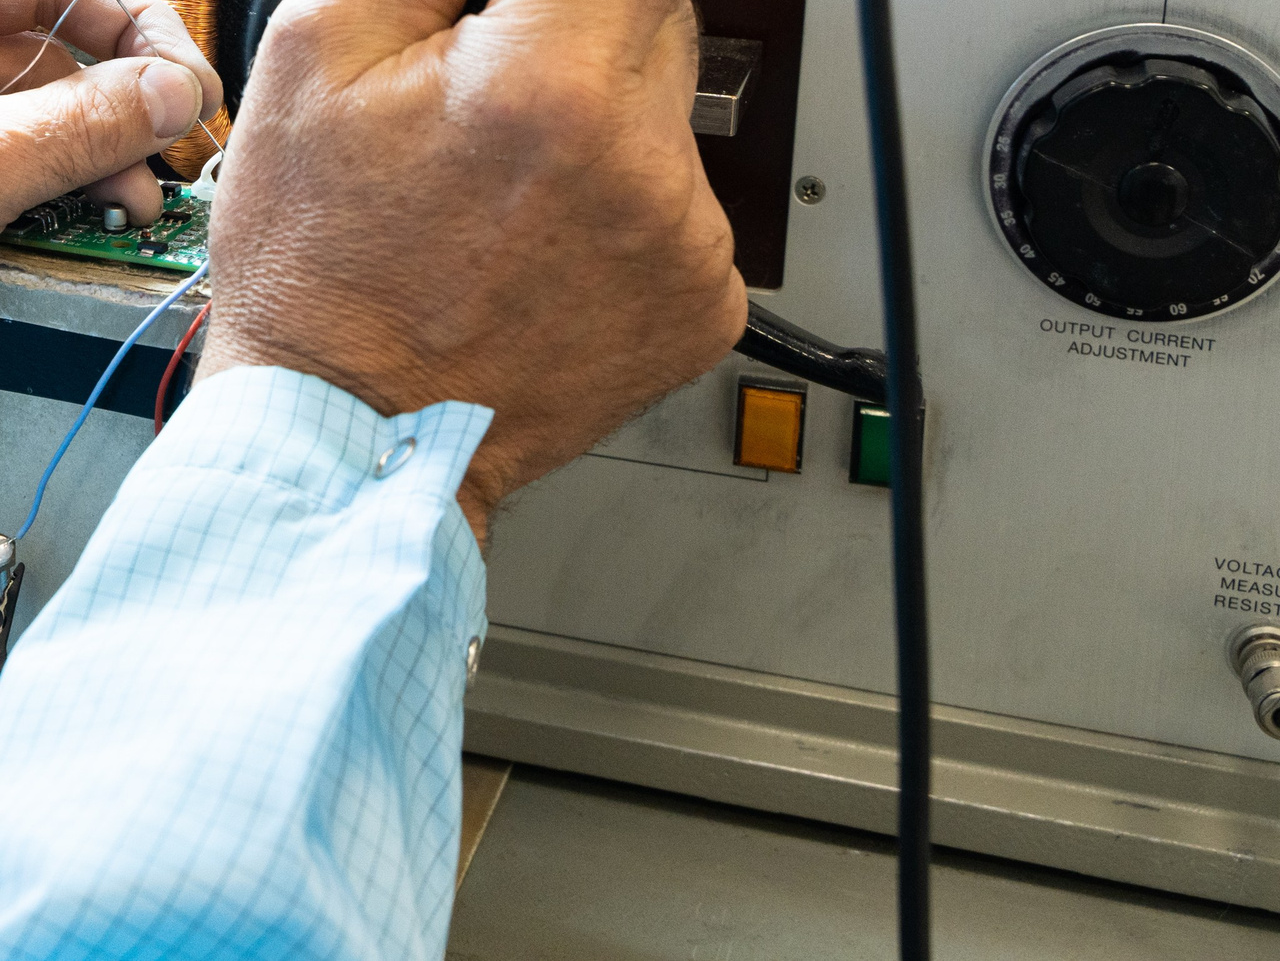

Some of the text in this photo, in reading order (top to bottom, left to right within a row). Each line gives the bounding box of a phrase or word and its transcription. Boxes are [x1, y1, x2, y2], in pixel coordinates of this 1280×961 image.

[996, 135, 1011, 152] 25
[993, 173, 1008, 189] 30
[1000, 210, 1016, 227] 35
[1020, 243, 1036, 259] 40
[1047, 272, 1066, 287] 45
[1039, 318, 1216, 352] OUTPUT CURRENT
[1067, 340, 1192, 367] ADJUSTMENT
